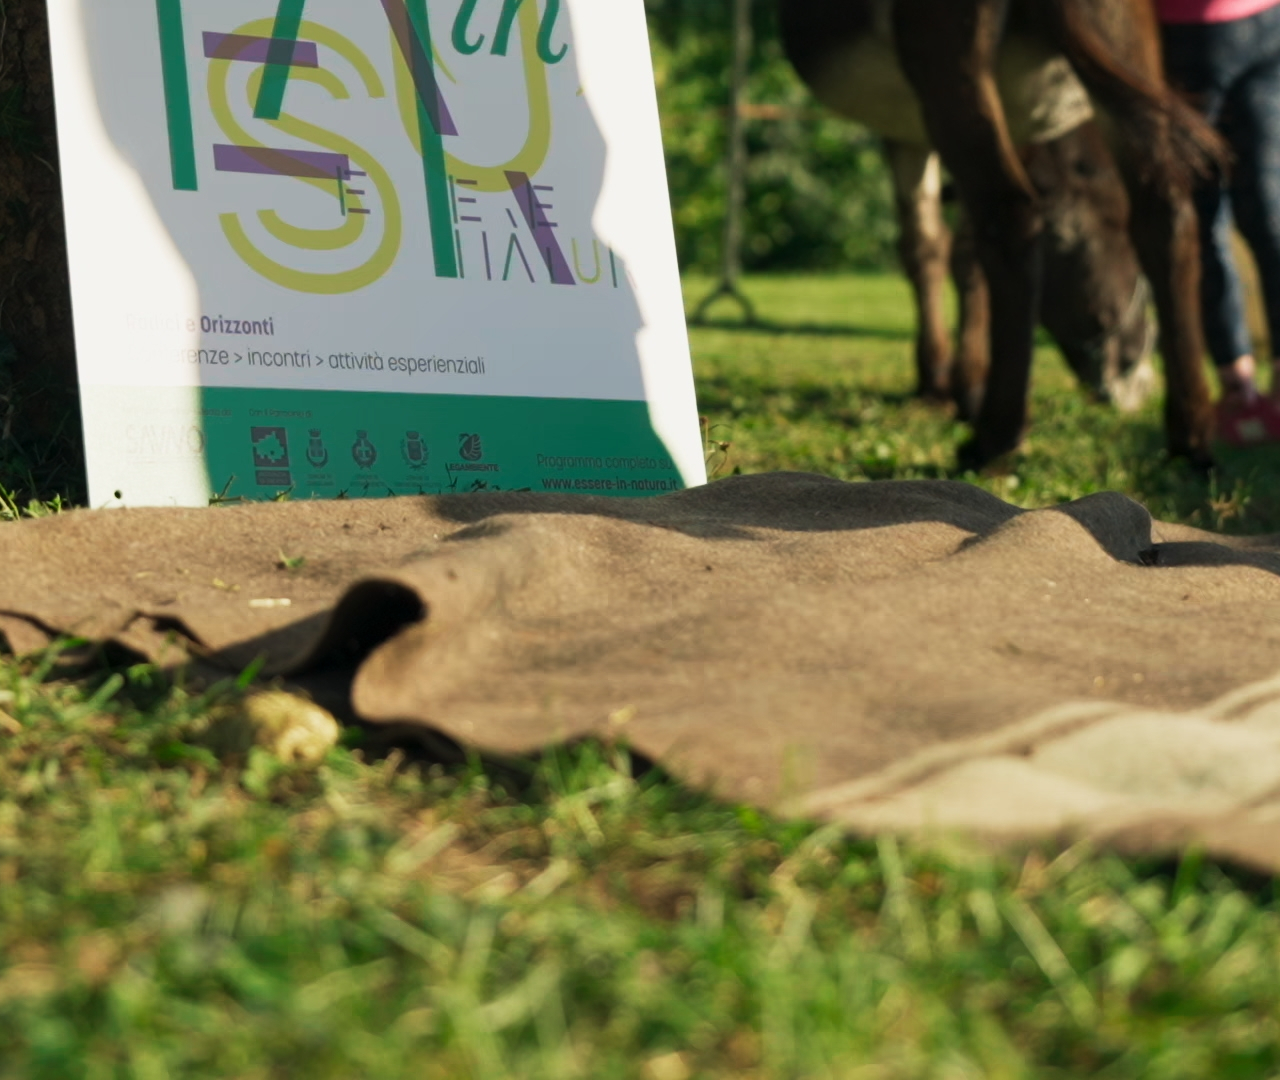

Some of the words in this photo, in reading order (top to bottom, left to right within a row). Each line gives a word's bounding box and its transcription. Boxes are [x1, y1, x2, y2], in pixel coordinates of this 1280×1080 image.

[200, 314, 275, 336] Orizzonti
[247, 347, 311, 368] incontri
[328, 351, 384, 371] attività
[388, 355, 486, 376] esperienziali
[536, 453, 602, 470] Programma
[605, 455, 657, 470] completo
[542, 476, 678, 491] www.essere-in-natura.it
